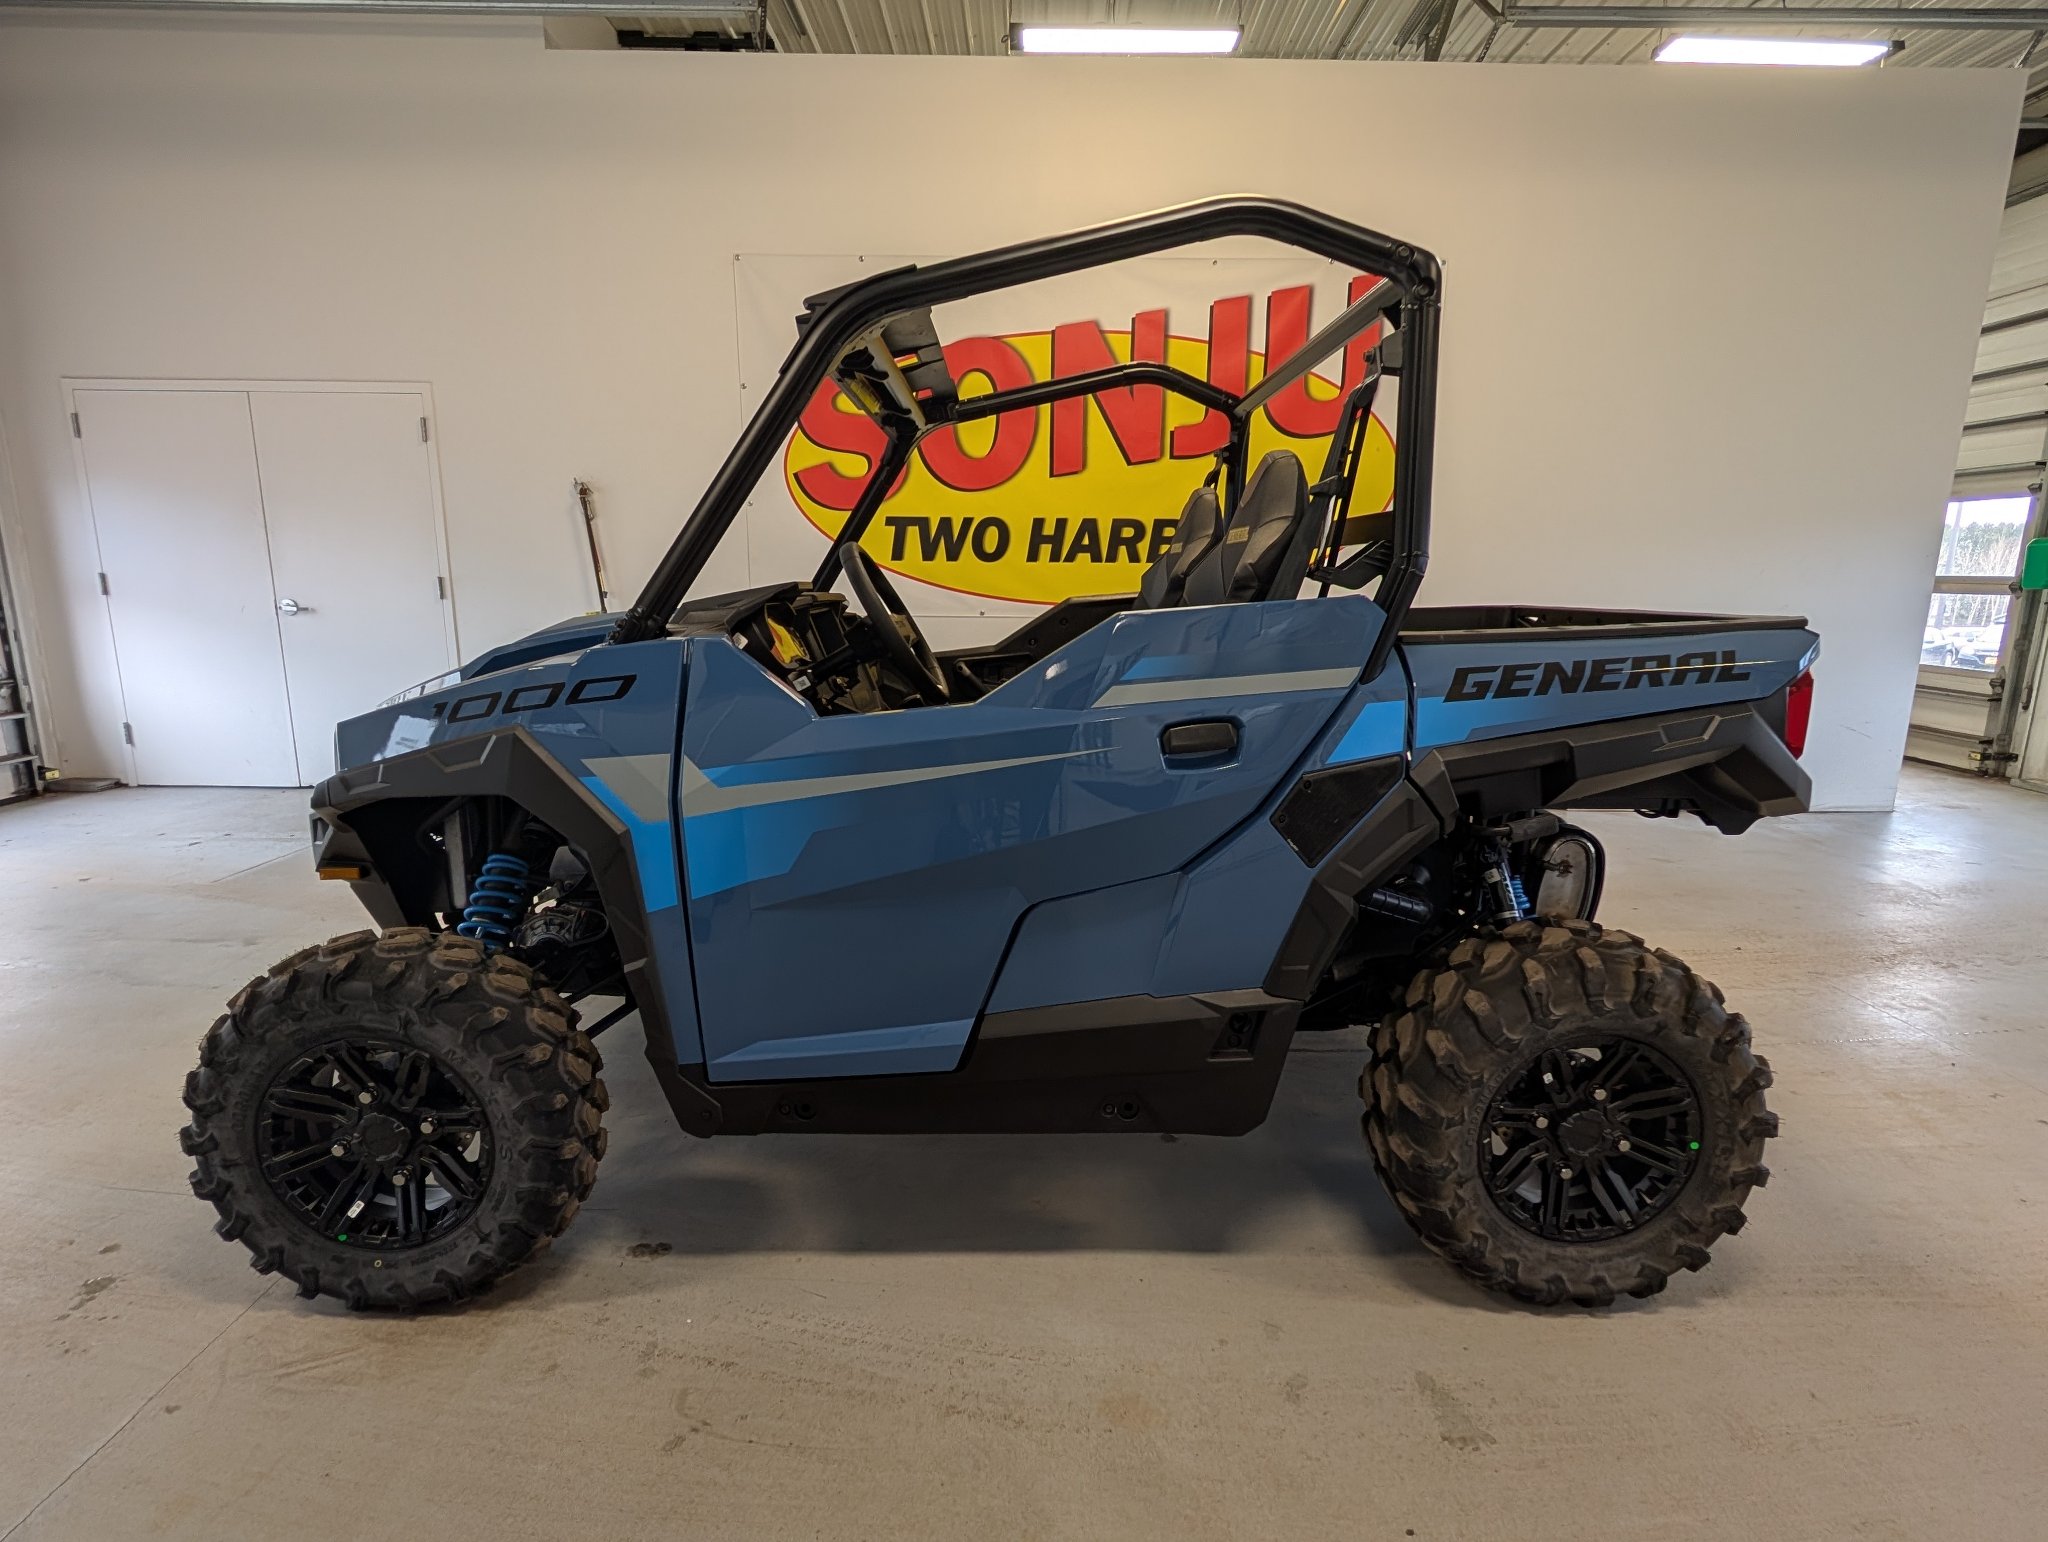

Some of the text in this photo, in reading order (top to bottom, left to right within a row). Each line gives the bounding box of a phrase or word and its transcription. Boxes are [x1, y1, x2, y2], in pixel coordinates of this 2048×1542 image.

[793, 275, 1384, 511] SONJU
[884, 516, 1180, 564] TWO HARB
[432, 674, 637, 725] 1000
[1442, 649, 1753, 704] GENERAL
